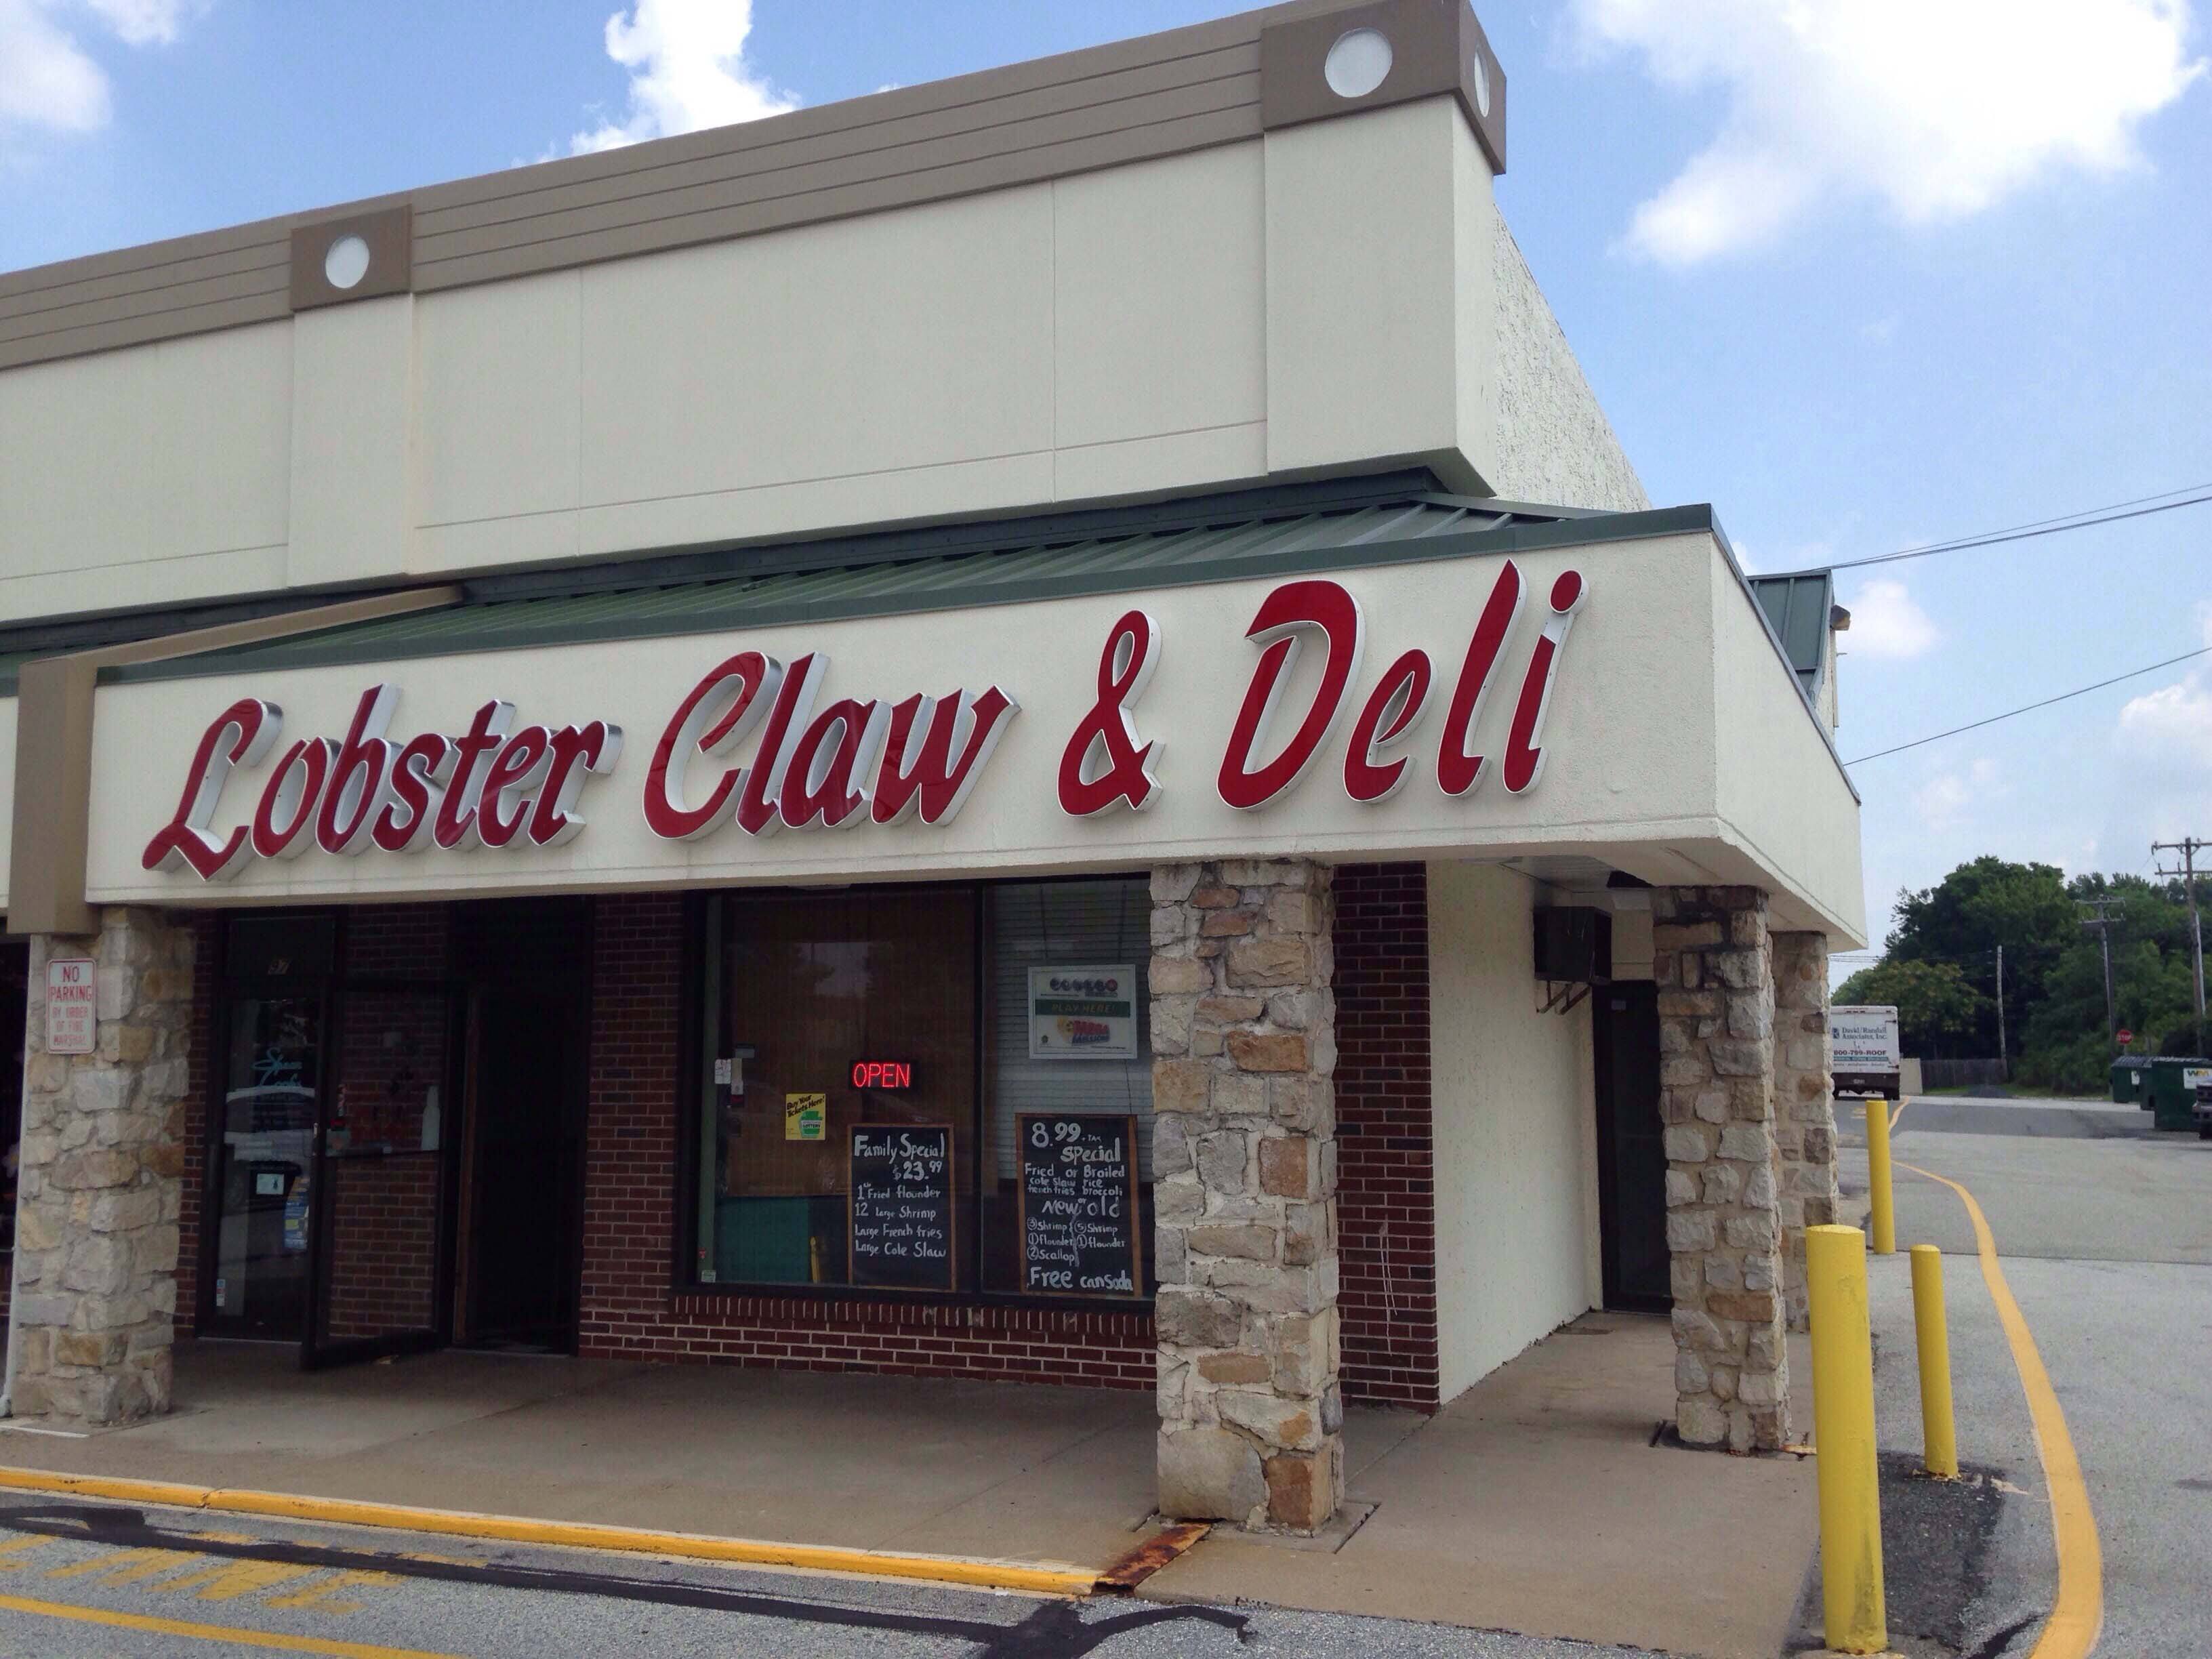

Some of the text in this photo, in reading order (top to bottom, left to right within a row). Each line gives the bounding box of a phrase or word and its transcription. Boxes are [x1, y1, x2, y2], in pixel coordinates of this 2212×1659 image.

[142, 558, 1586, 881] Lobster Claw & Deli
[62, 966, 79, 982] NO
[49, 985, 92, 1002] PARKING
[853, 1063, 911, 1088] OPEN
[787, 1095, 812, 1110] Buy Your
[787, 1095, 825, 1118] Tickets Here!
[1031, 1122, 1081, 1147] 8.99
[854, 1133, 945, 1164] Family Special
[1025, 1162, 1125, 1178] Fried or Broiled
[867, 1187, 890, 1199] Fried
[896, 1185, 941, 1199] flounder
[1053, 1186, 1076, 1195] fries
[1082, 1185, 1123, 1196] broccoli
[1084, 1179, 1103, 1188] rice
[855, 1202, 869, 1216] 12
[899, 1206, 937, 1221] Shrimp
[1042, 1200, 1080, 1215] New
[855, 1223, 942, 1239] Large French fries
[855, 1240, 947, 1258] Large Cole Slaw
[1031, 1267, 1073, 1288] Free
